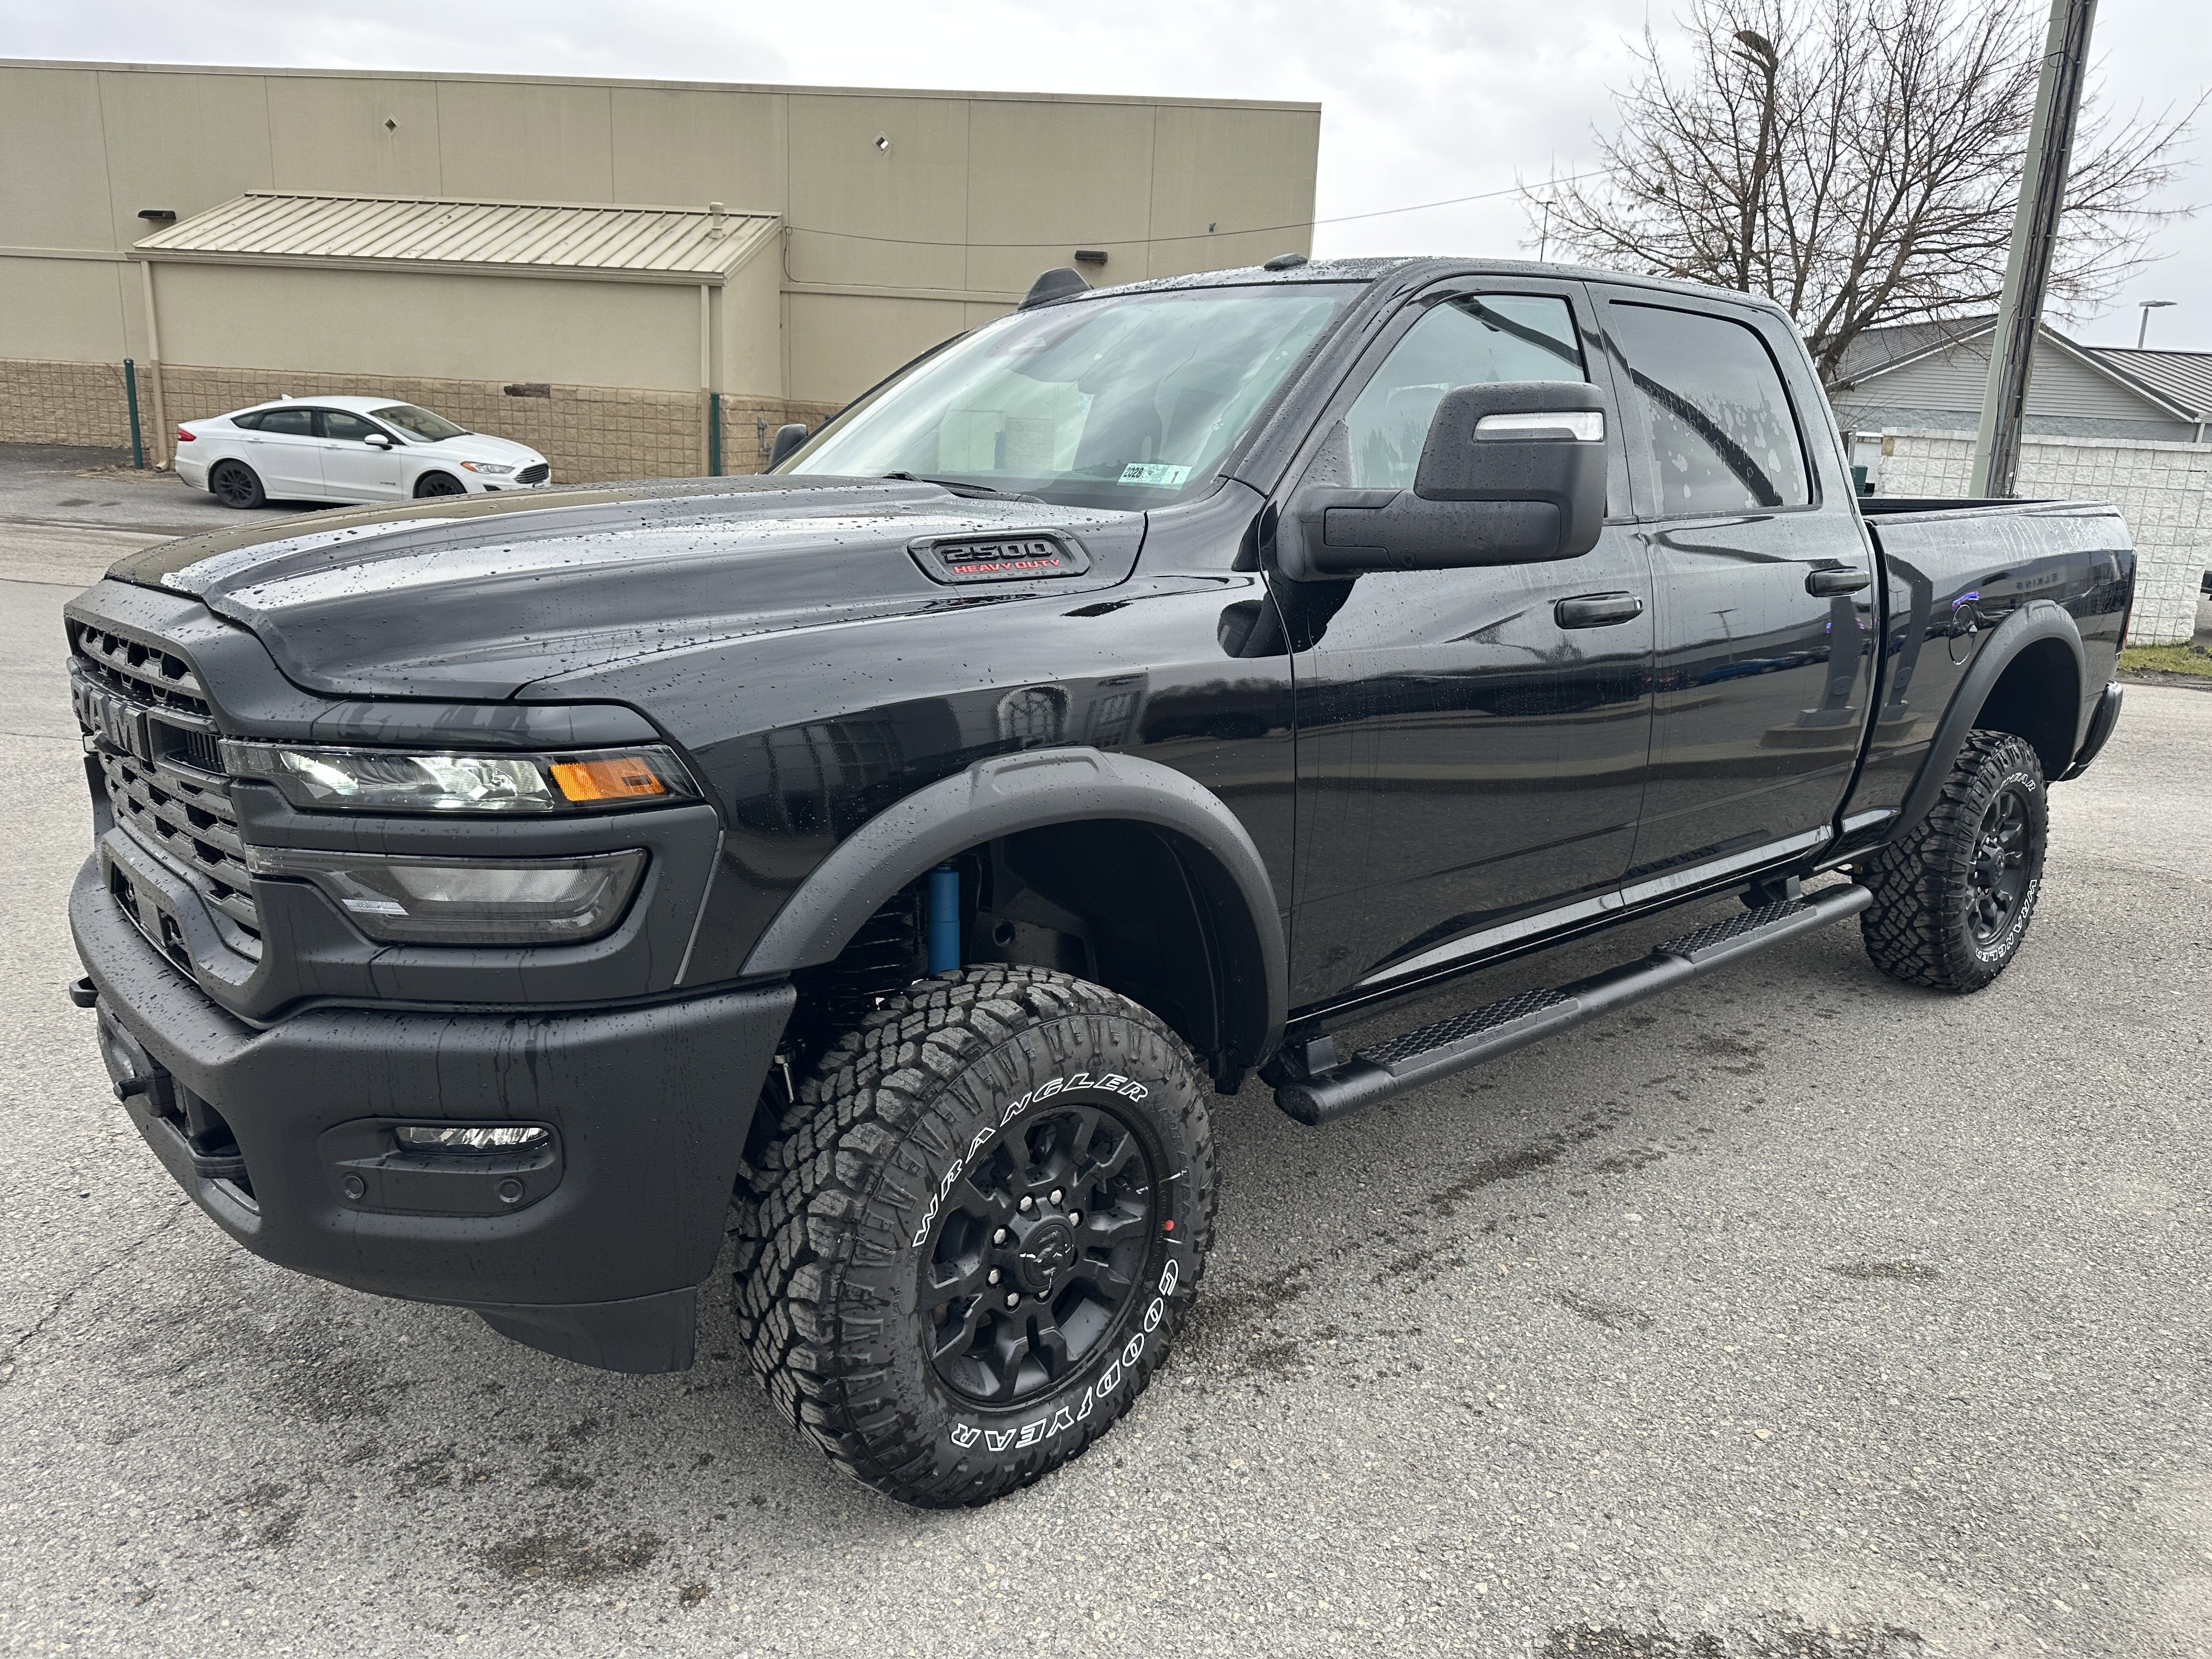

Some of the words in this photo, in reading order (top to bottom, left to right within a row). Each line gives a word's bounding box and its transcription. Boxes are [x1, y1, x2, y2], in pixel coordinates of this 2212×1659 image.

[1123, 467, 1144, 478] 2028
[940, 541, 1053, 563] 2500
[952, 562, 1012, 574] HEAVY
[1015, 558, 1061, 569] DUTY
[70, 674, 152, 763] RAM
[1975, 879, 2038, 962] WRANGLER
[912, 1073, 1148, 1248] WRANGLER
[951, 1259, 1178, 1452] GOODYEAR
